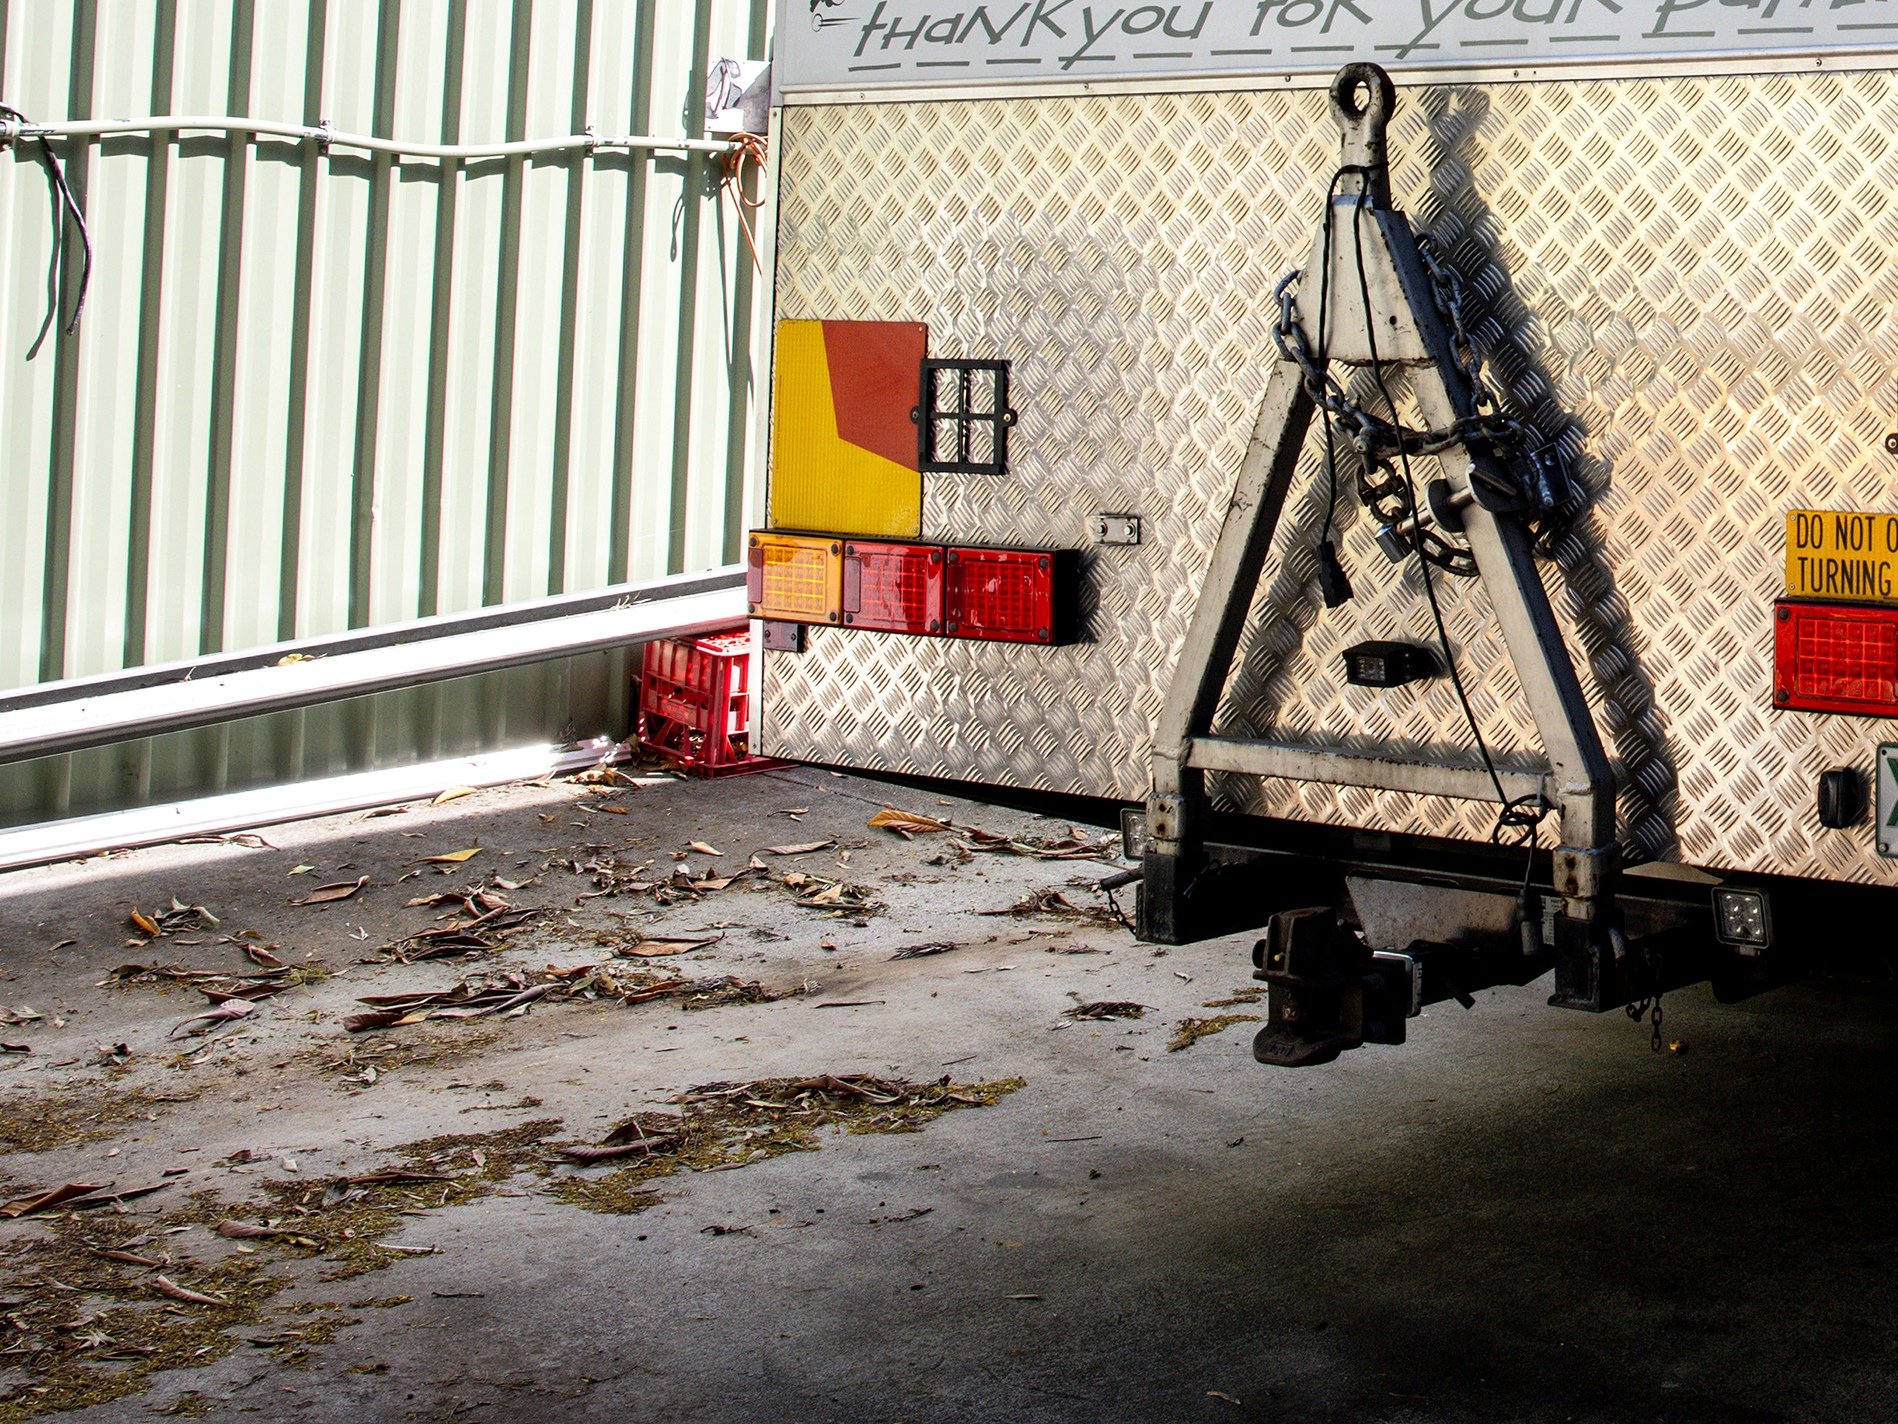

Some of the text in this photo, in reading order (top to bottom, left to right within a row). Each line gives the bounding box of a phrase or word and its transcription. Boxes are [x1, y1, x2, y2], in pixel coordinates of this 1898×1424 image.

[1797, 514, 1823, 550] DO
[1834, 514, 1877, 553] NOT
[1797, 557, 1892, 596] TURNING
